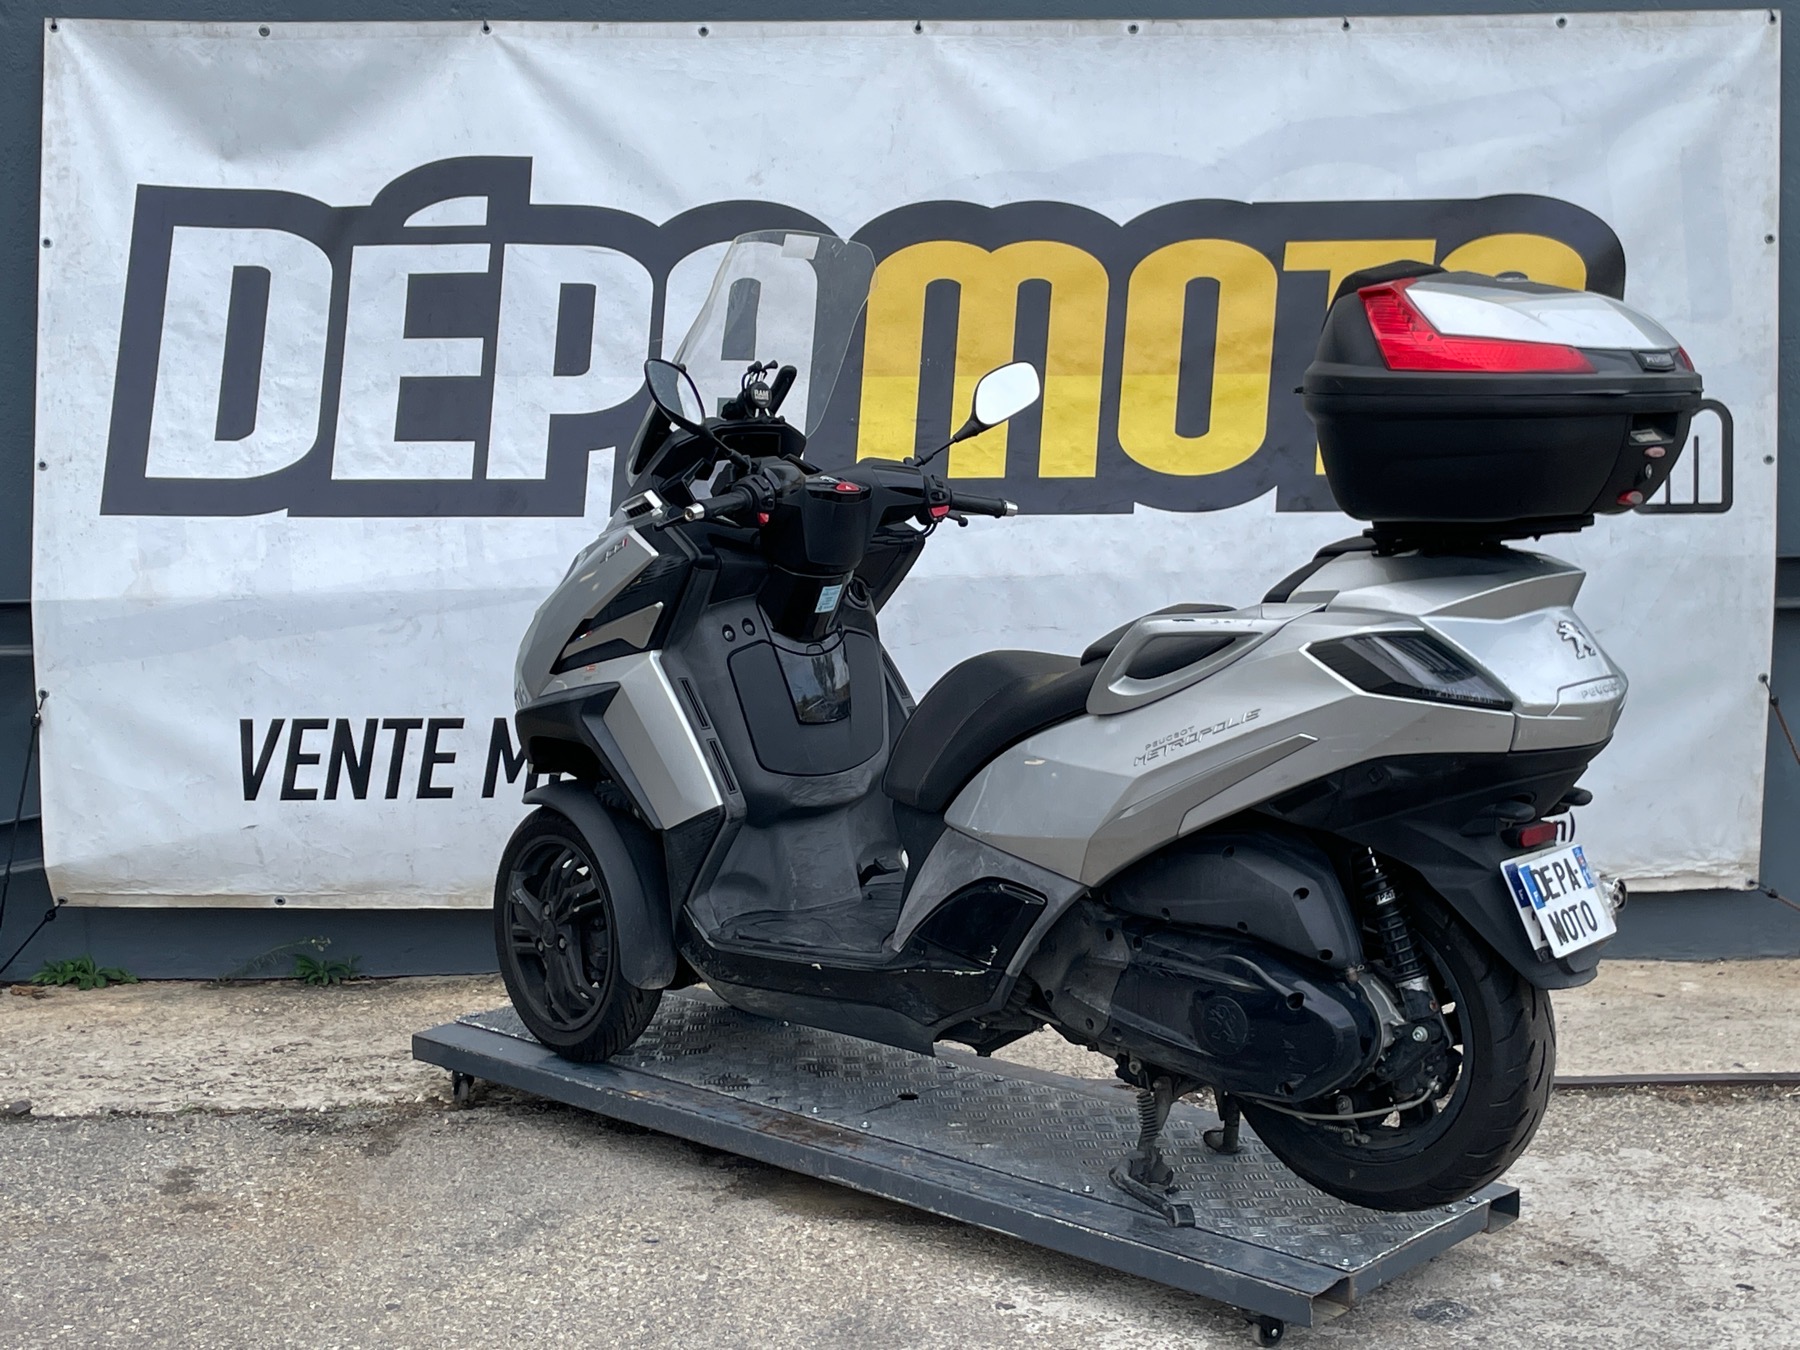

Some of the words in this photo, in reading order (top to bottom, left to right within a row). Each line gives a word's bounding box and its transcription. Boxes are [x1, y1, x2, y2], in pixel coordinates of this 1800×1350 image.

[855, 232, 1588, 479] MOT
[239, 717, 465, 801] VENTE
[1133, 708, 1262, 767] METROPOLIS
[1144, 725, 1195, 751] PEUGEOT
[1548, 900, 1598, 946] MOTO
